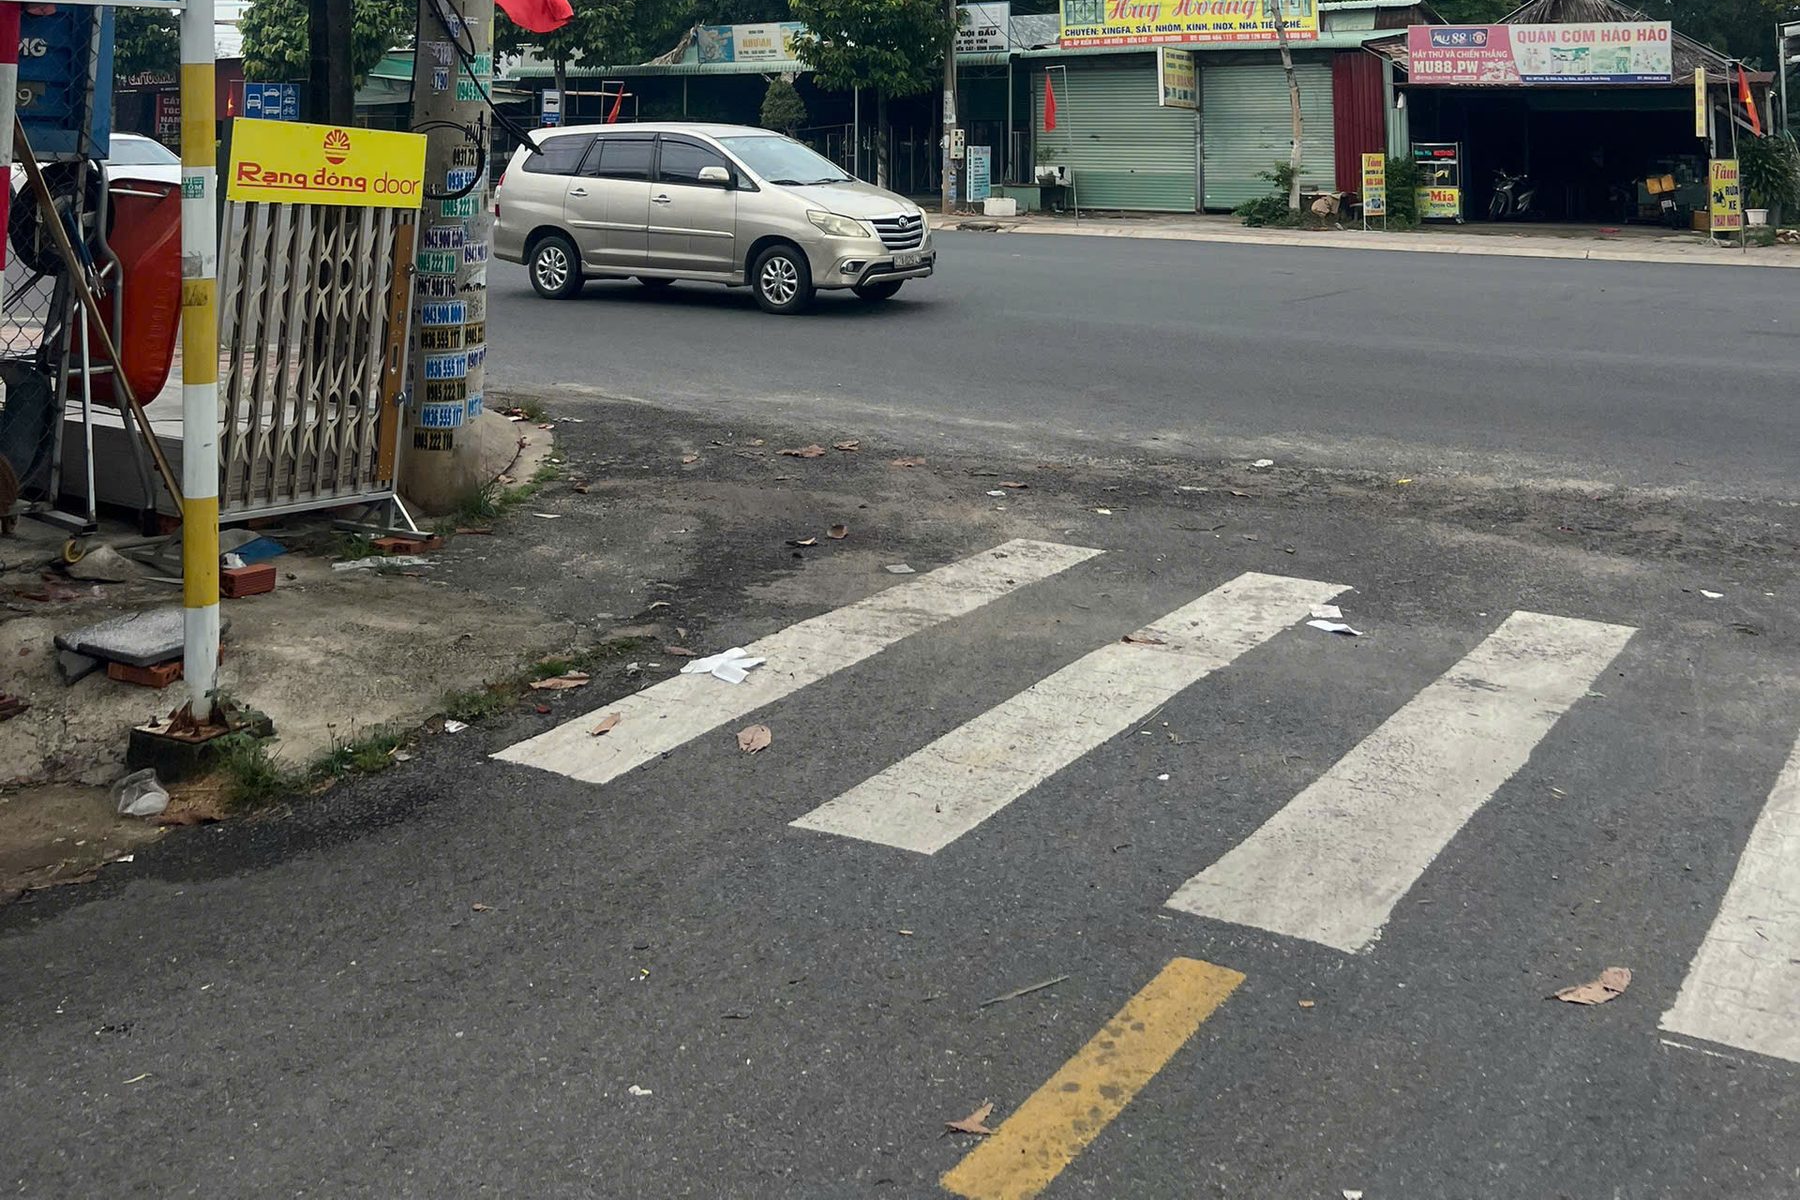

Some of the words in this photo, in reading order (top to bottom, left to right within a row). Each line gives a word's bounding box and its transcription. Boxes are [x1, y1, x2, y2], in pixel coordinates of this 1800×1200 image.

[1517, 27, 1556, 43] QUÁN
[1561, 28, 1595, 43] CƠM
[1413, 60, 1478, 73] MU88.PW
[237, 162, 307, 188] Rạng
[374, 172, 419, 195] door
[1729, 200, 1737, 210] XE
[443, 359, 455, 377] 555
